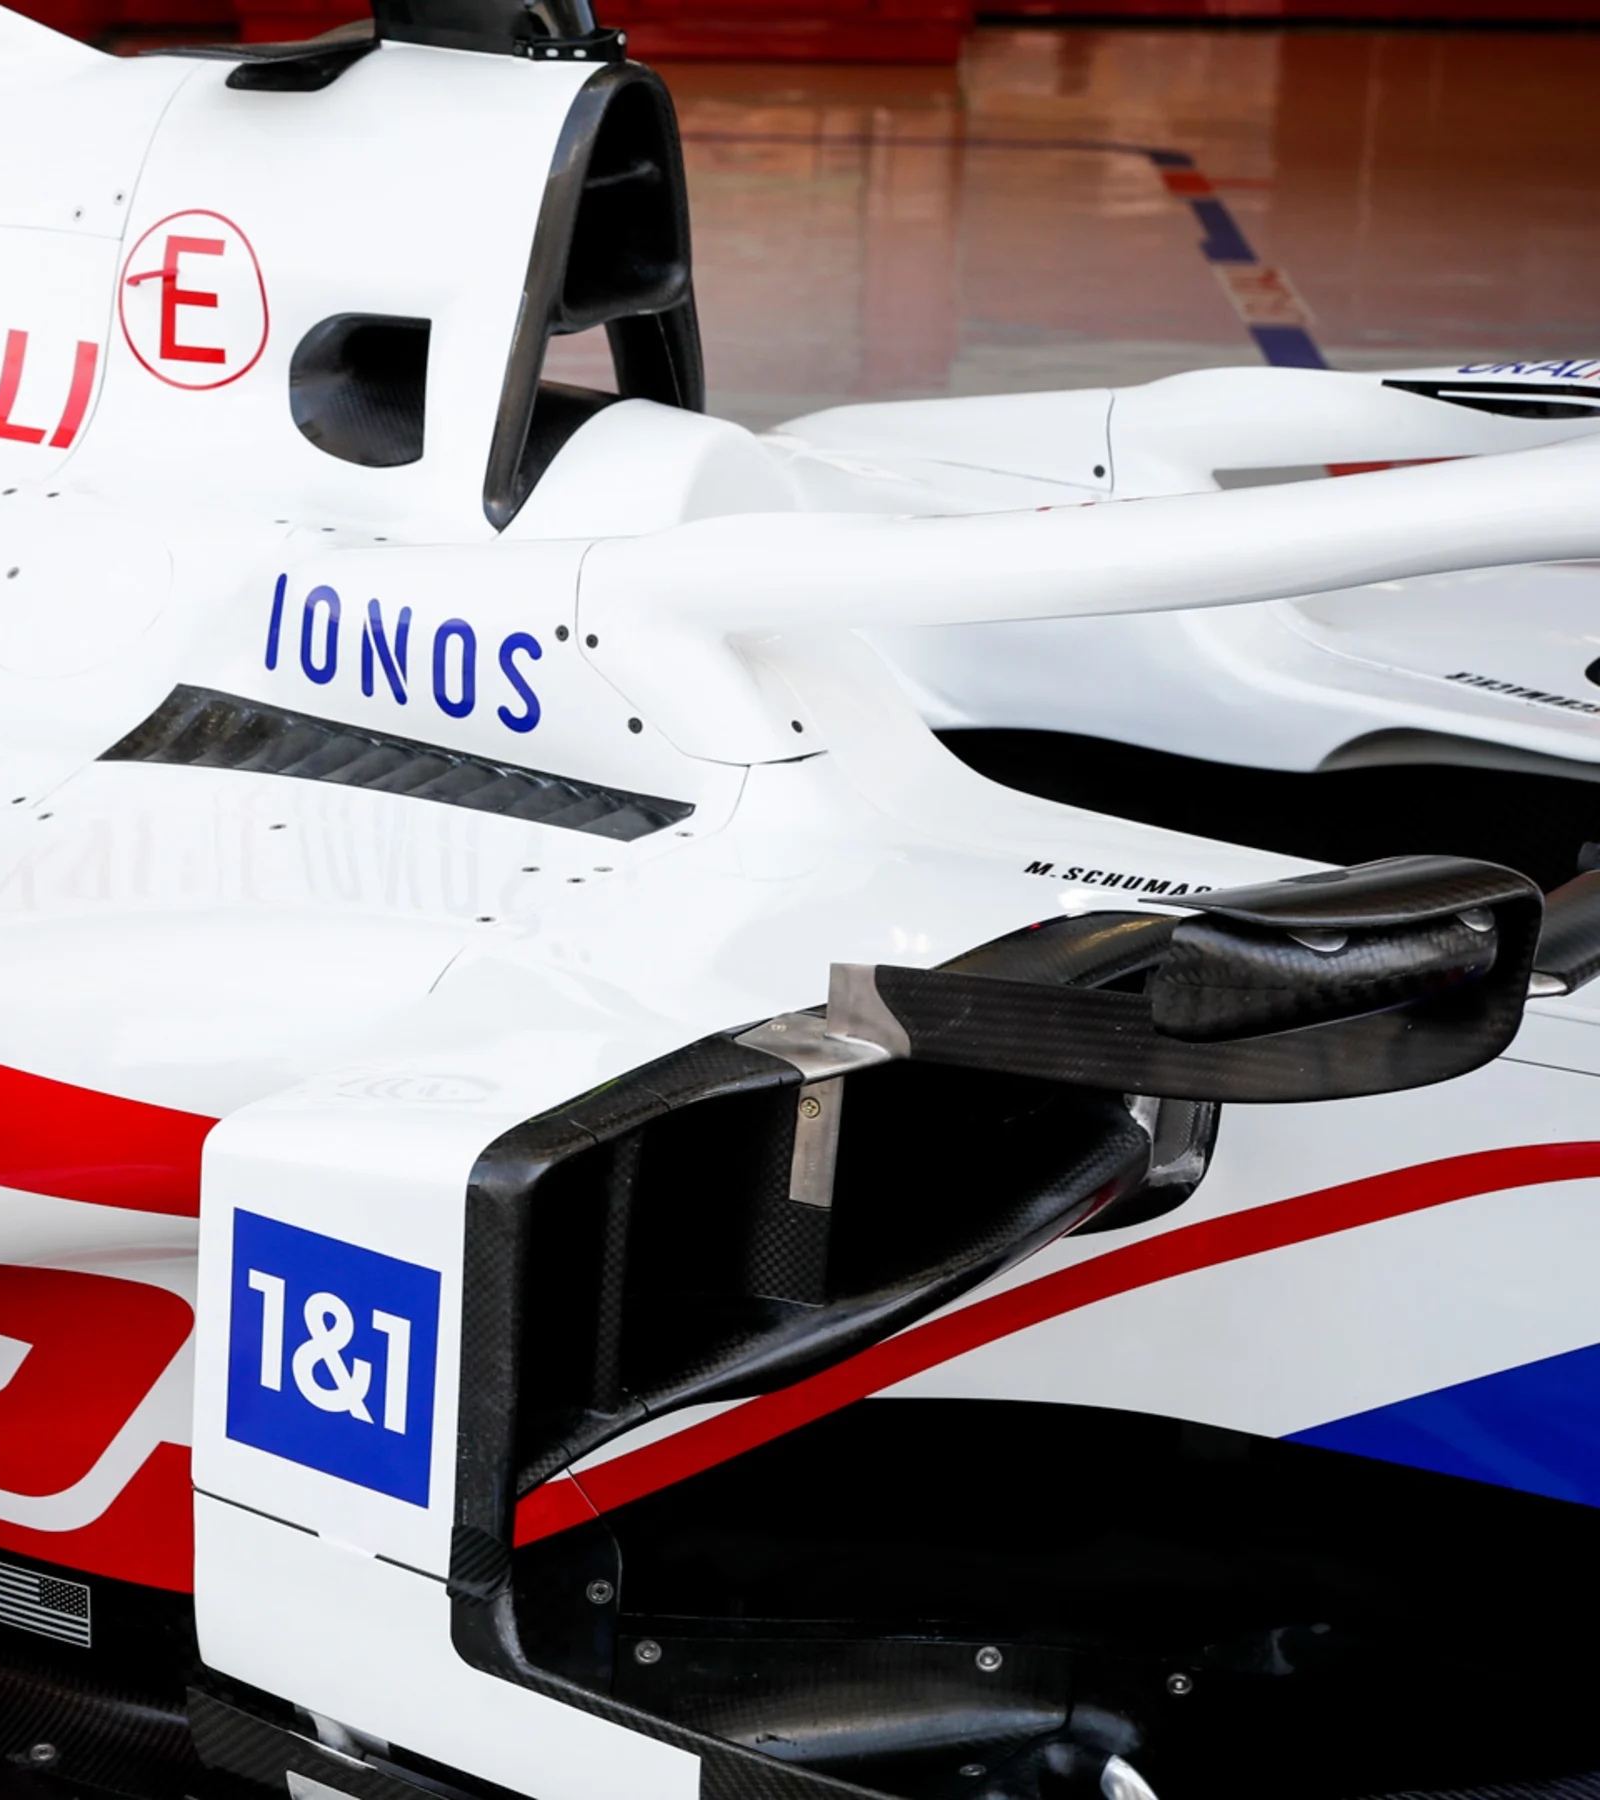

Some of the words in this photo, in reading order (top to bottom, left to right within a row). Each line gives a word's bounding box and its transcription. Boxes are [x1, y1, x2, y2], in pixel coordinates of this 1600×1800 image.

[159, 235, 226, 364] E
[265, 573, 543, 734] IONOS
[247, 1267, 413, 1437] 1&1
